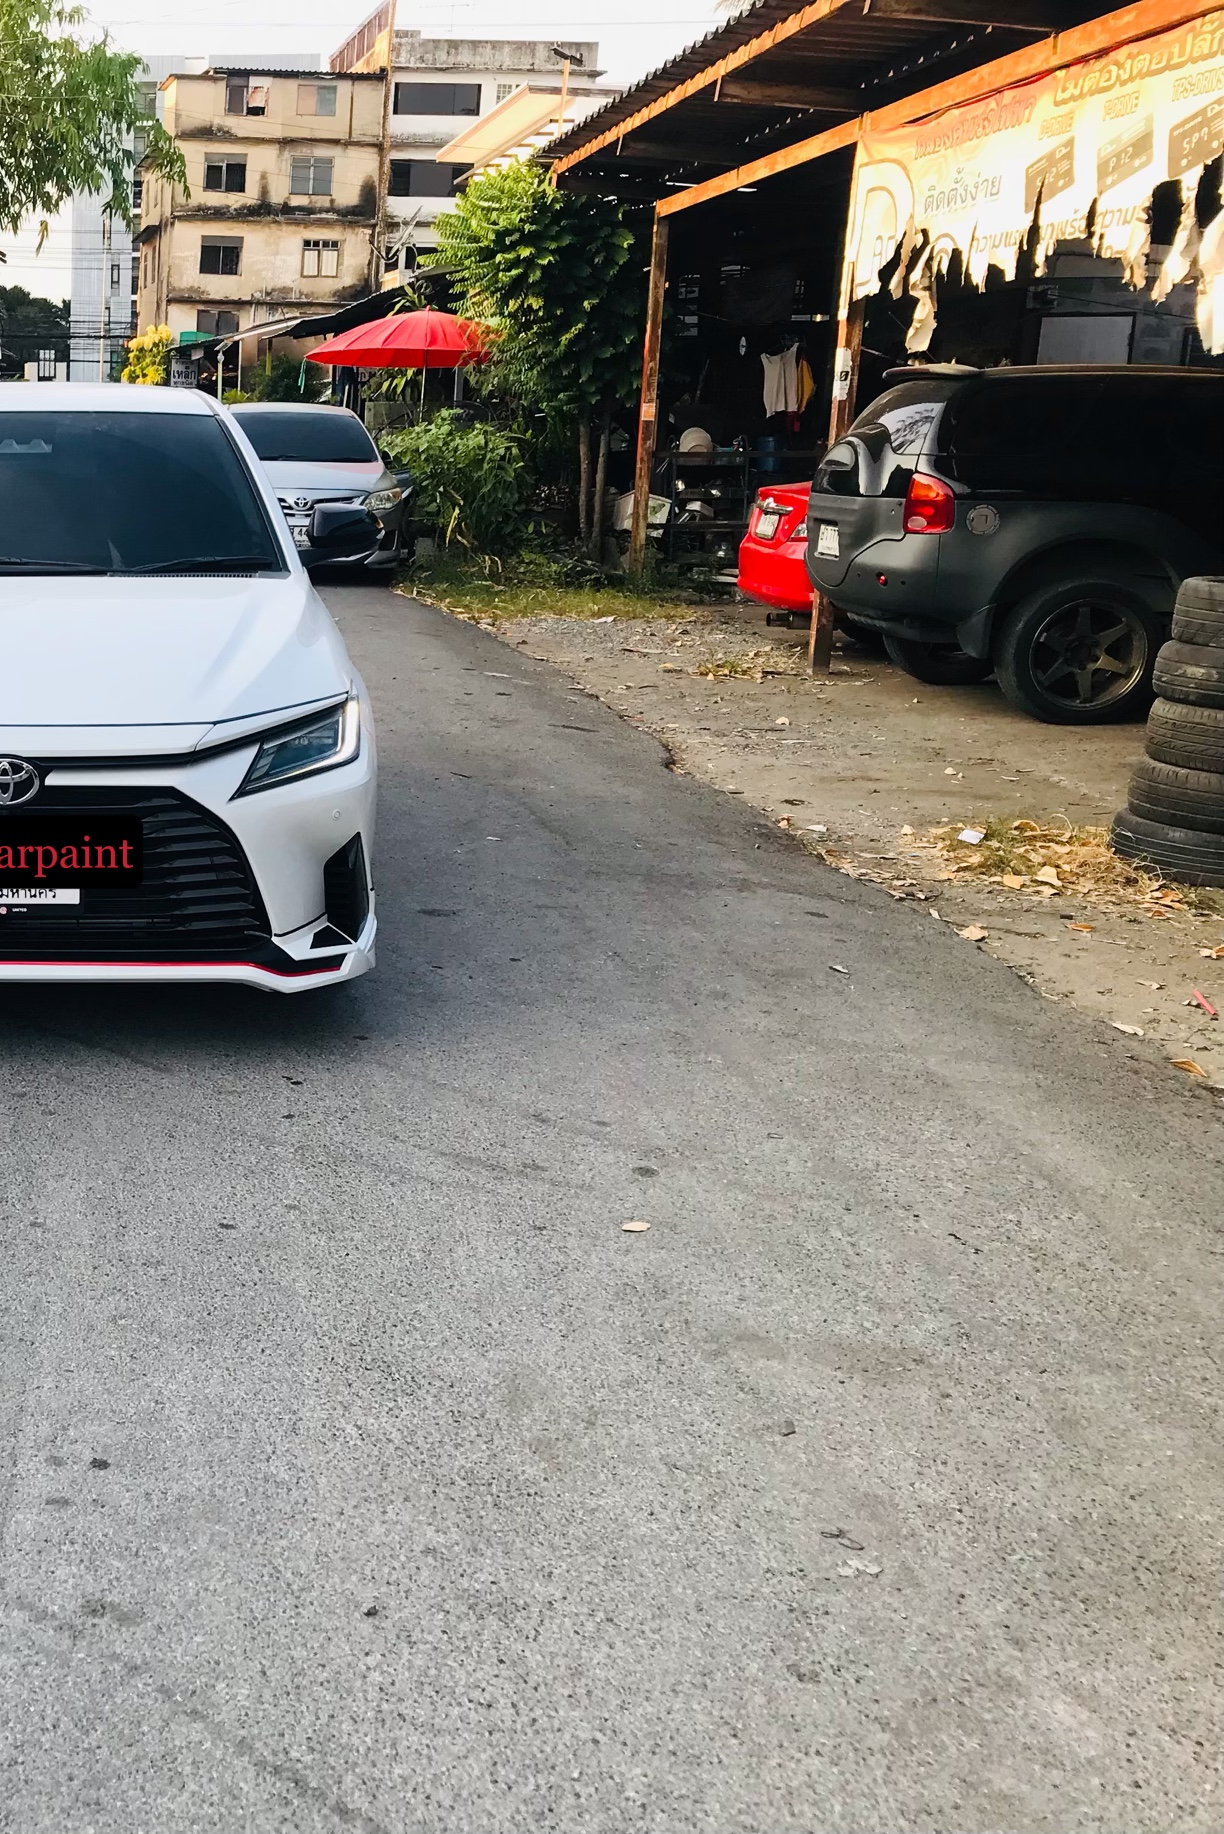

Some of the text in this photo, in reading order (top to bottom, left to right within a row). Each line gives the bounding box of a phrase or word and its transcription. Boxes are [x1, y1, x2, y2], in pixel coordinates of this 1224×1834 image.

[924, 167, 1002, 214] ติดตั้งง่าย
[173, 365, 196, 380] เหล็ก
